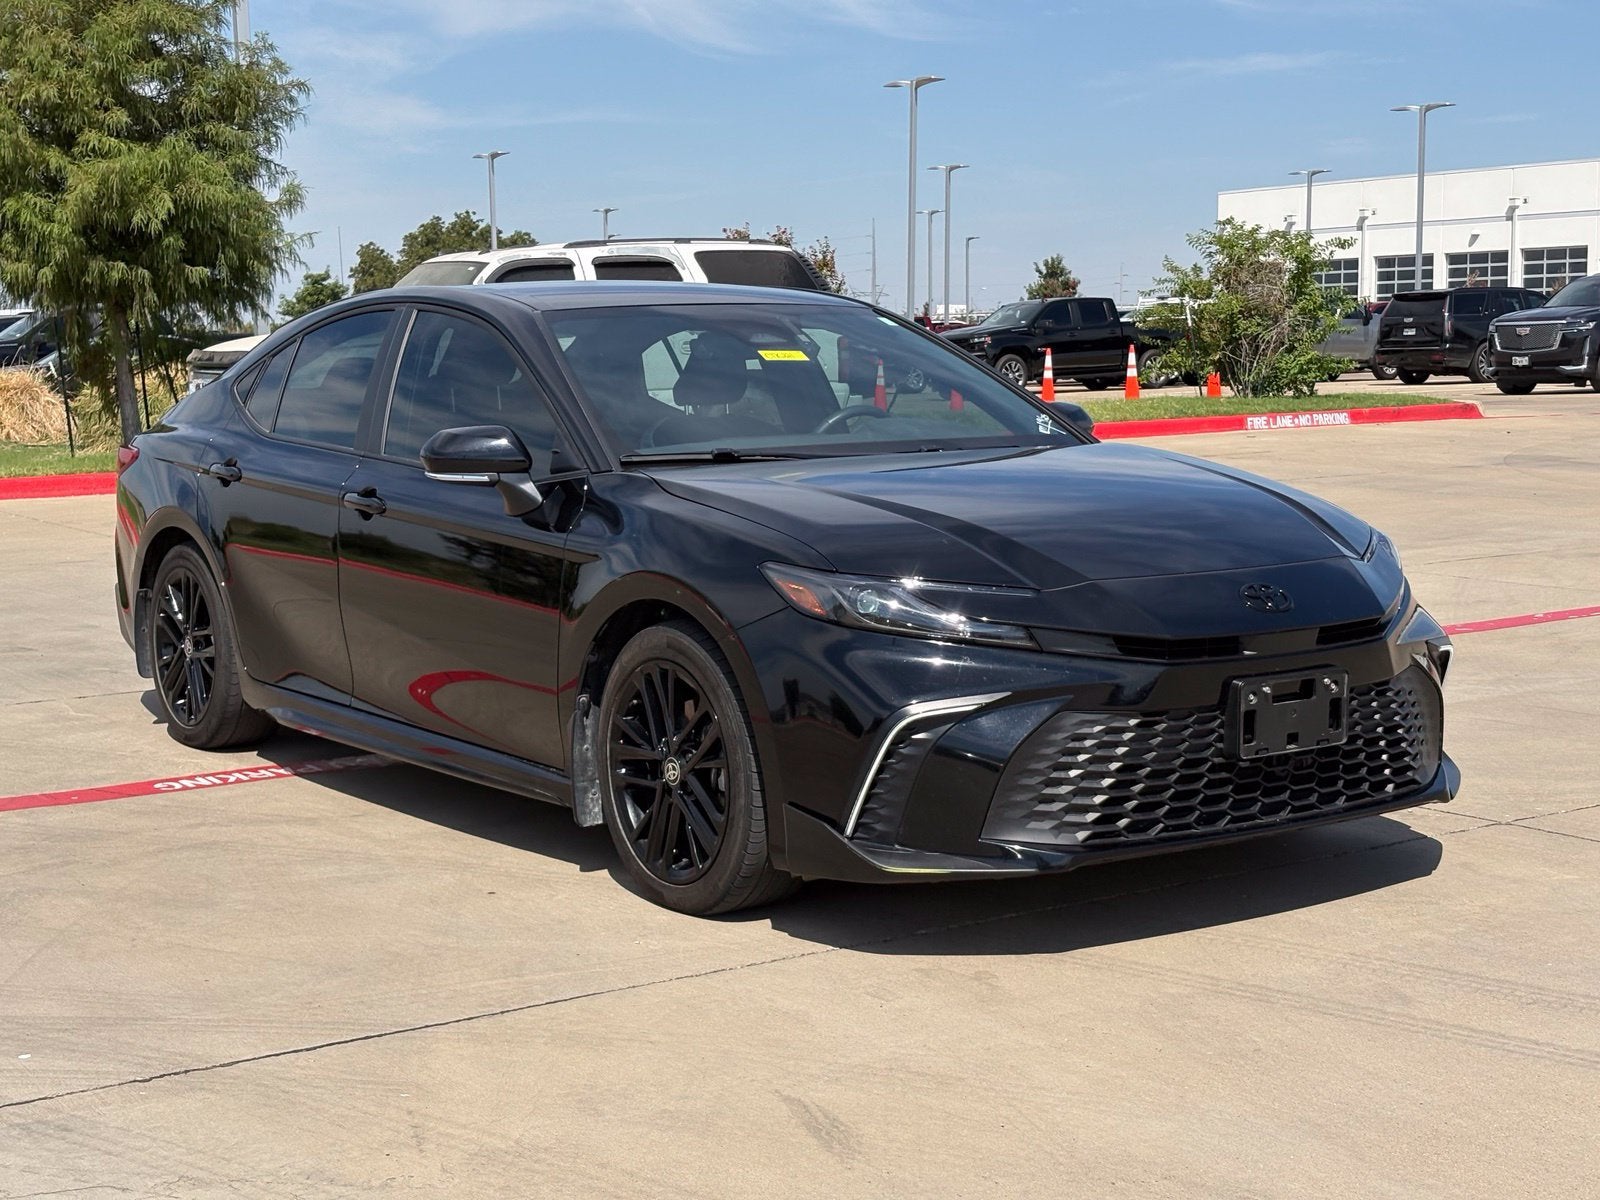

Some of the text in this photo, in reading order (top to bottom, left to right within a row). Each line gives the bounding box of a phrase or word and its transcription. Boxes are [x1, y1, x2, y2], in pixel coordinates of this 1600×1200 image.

[1247, 412, 1350, 430] FIRE LANE NO PARKING
